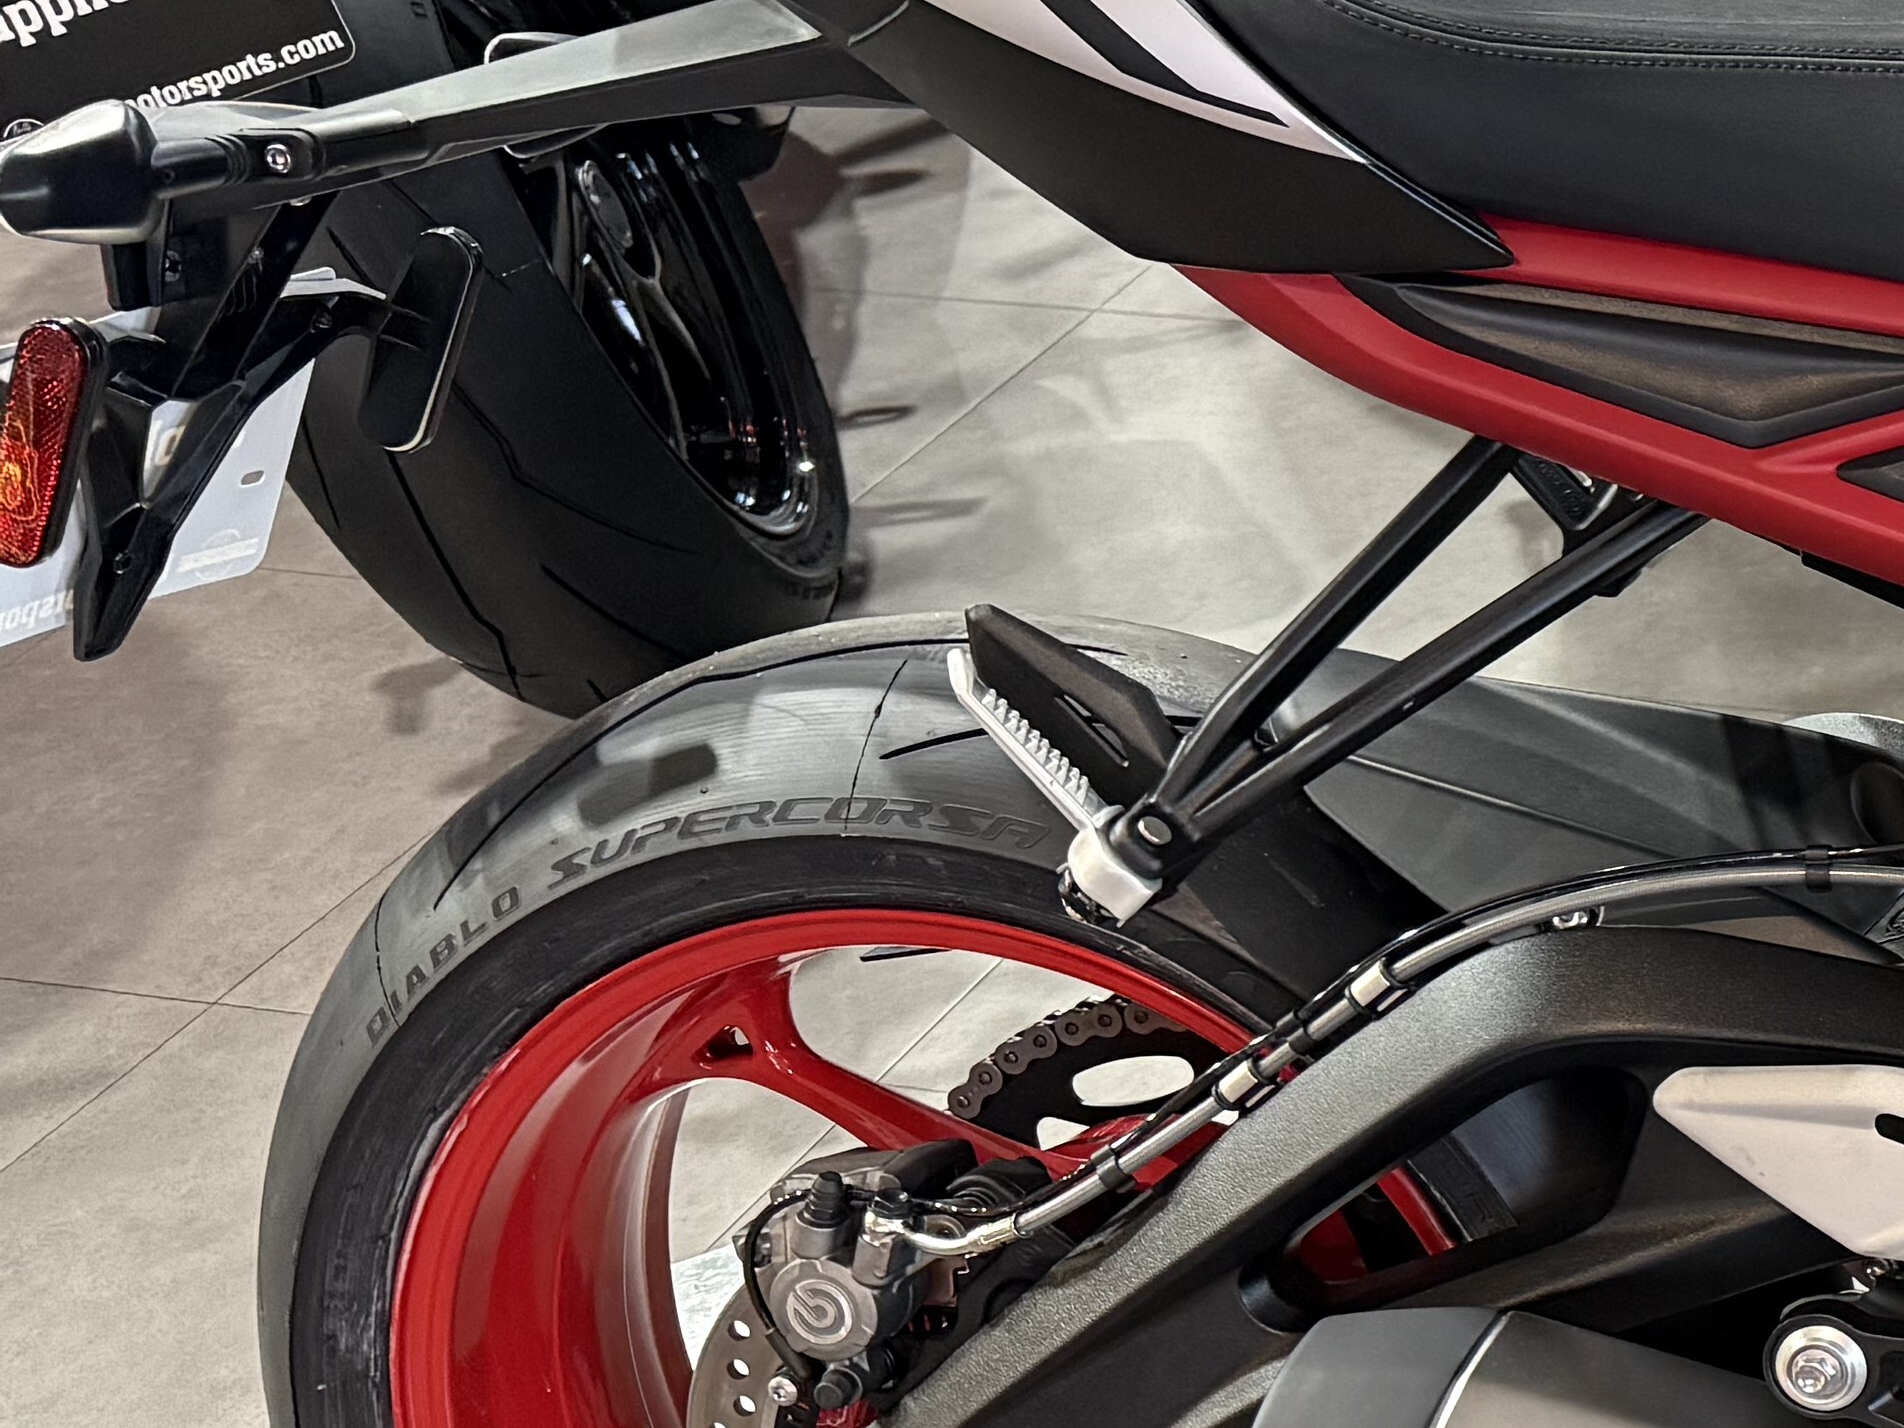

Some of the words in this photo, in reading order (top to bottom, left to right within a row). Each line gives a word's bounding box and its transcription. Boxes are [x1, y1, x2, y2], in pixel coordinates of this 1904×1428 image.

[126, 29, 345, 109] otorsports.com
[366, 885, 522, 1050] DIABLO
[549, 795, 1051, 891] SUPERCORSA
